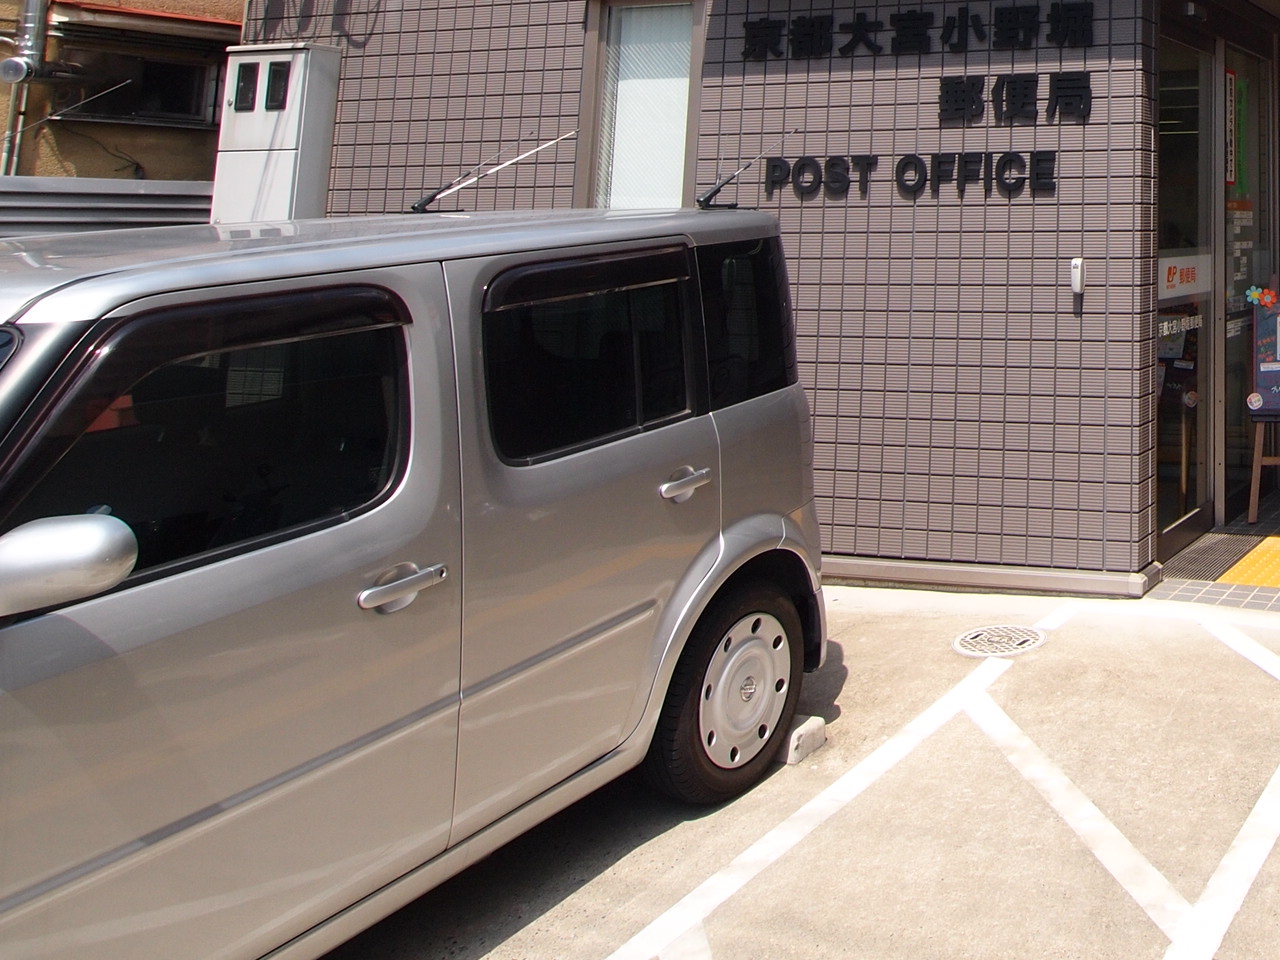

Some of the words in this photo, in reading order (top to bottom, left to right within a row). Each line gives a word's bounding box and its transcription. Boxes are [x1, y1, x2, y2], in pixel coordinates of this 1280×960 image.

[742, 2, 1095, 60] 京都大宮小野堀
[938, 72, 1093, 122] 郵便局
[765, 153, 878, 196] POST
[895, 150, 1057, 194] OFFICE
